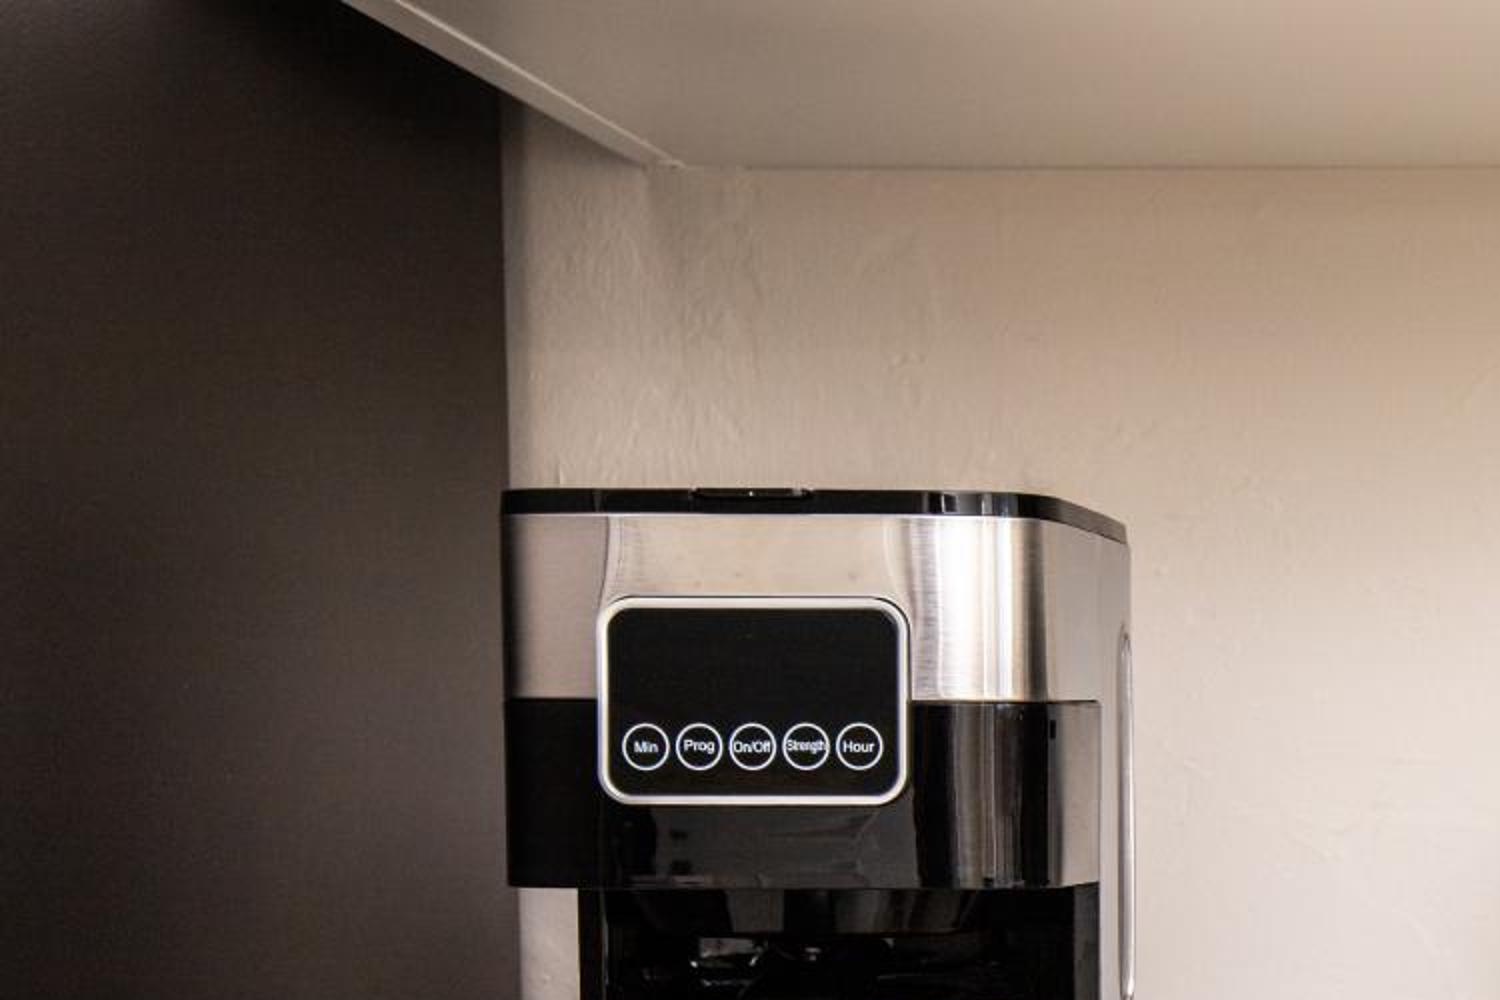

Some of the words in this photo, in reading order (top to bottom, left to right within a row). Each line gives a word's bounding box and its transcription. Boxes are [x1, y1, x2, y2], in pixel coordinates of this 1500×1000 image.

[634, 740, 659, 753] Min
[683, 739, 716, 755] Prog
[733, 741, 772, 753] On/Off
[786, 740, 829, 755] Strength
[842, 740, 875, 753] Hour
